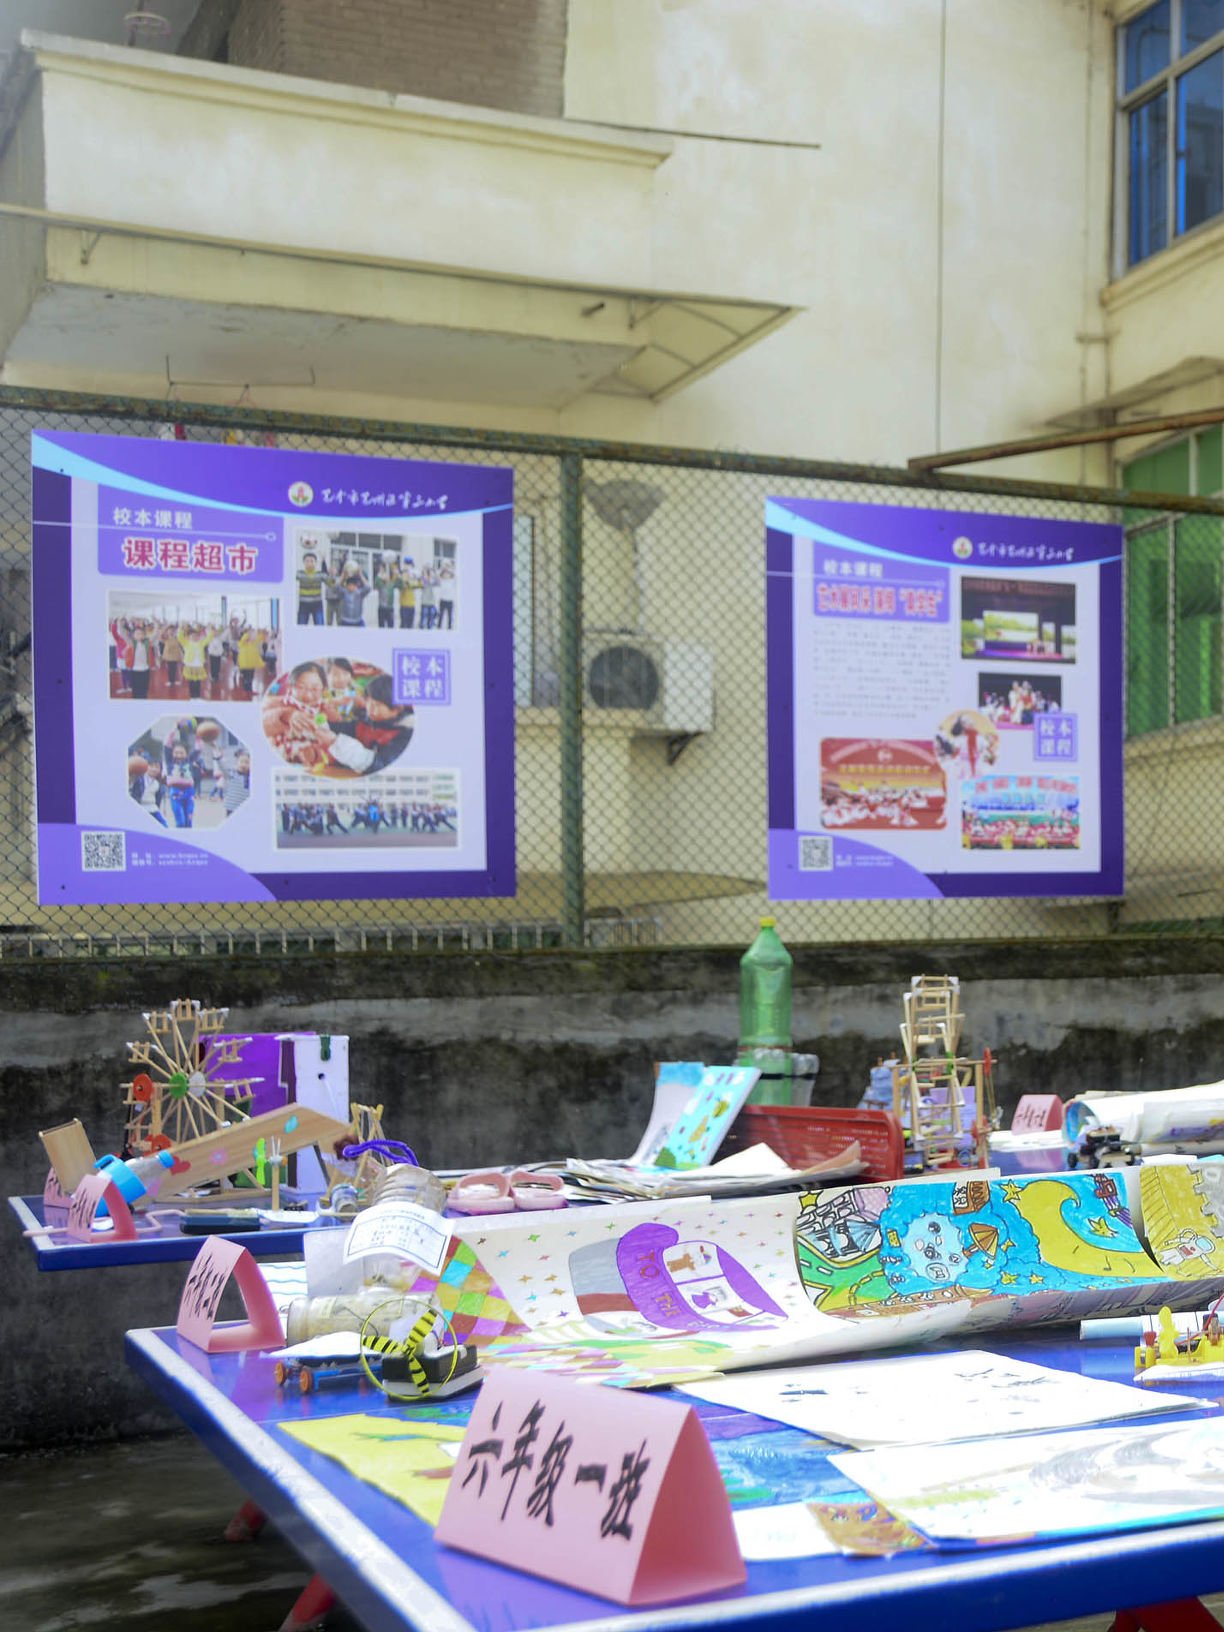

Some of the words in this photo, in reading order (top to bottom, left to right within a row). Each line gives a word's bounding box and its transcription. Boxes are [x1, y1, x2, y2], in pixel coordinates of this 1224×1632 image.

[113, 508, 193, 529] 校本课程
[123, 538, 258, 573] 课程超市
[401, 655, 444, 677] 校本
[402, 678, 444, 700] 课程
[636, 1248, 661, 1279] TO
[461, 1399, 651, 1541] 六年级一班
